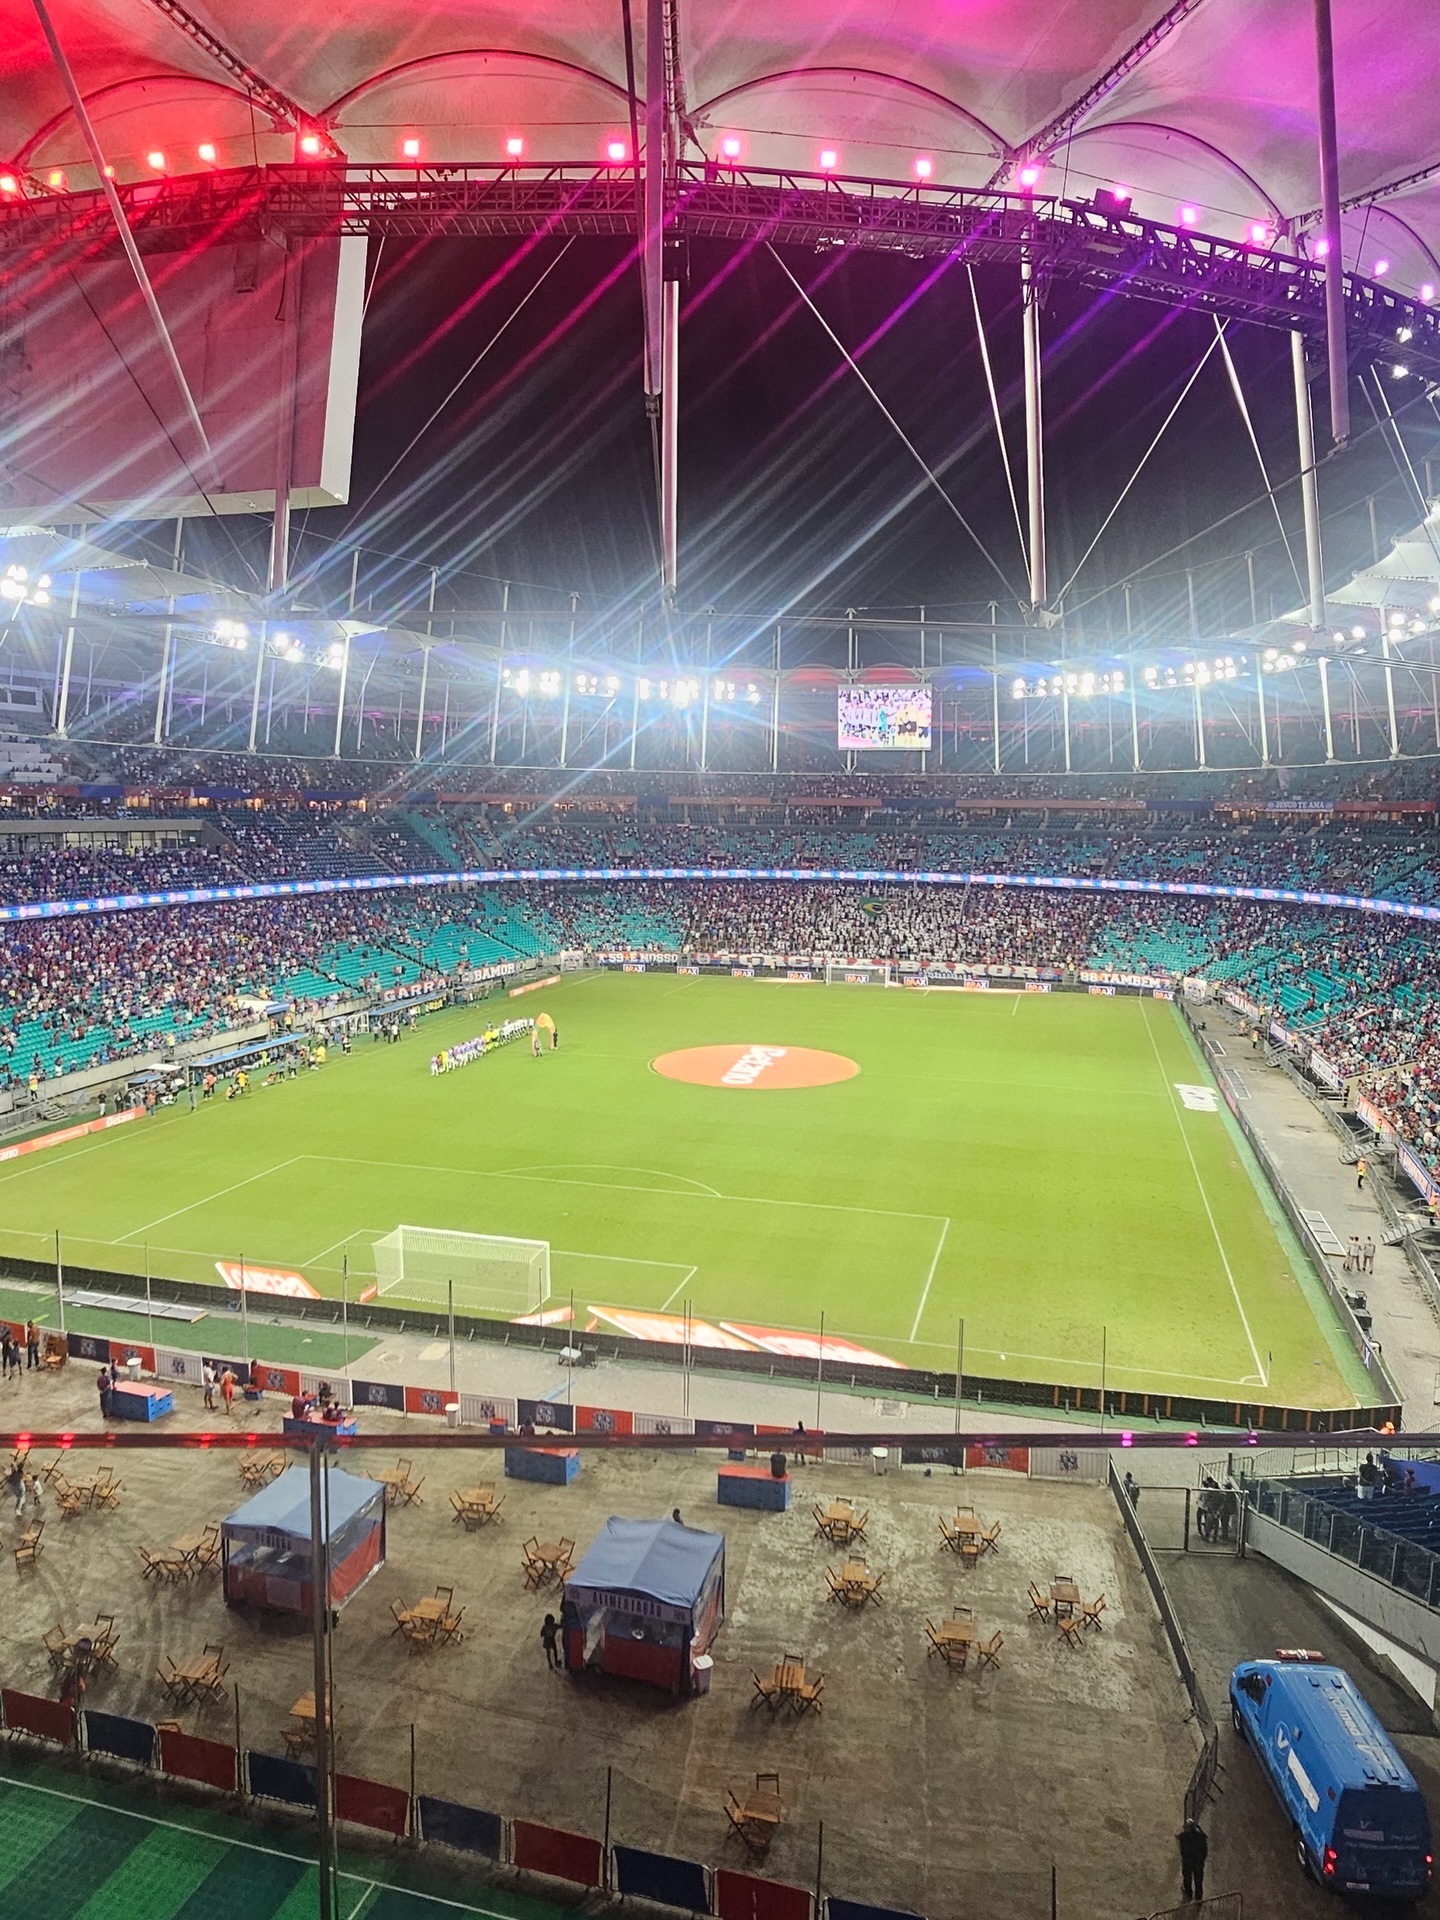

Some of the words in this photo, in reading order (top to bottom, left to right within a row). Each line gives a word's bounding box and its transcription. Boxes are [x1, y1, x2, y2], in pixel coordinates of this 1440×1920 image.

[1308, 801, 1325, 809] AMA
[640, 953, 679, 963] NOSSO
[474, 961, 516, 982] BAMOR
[383, 978, 448, 1000] GARRA
